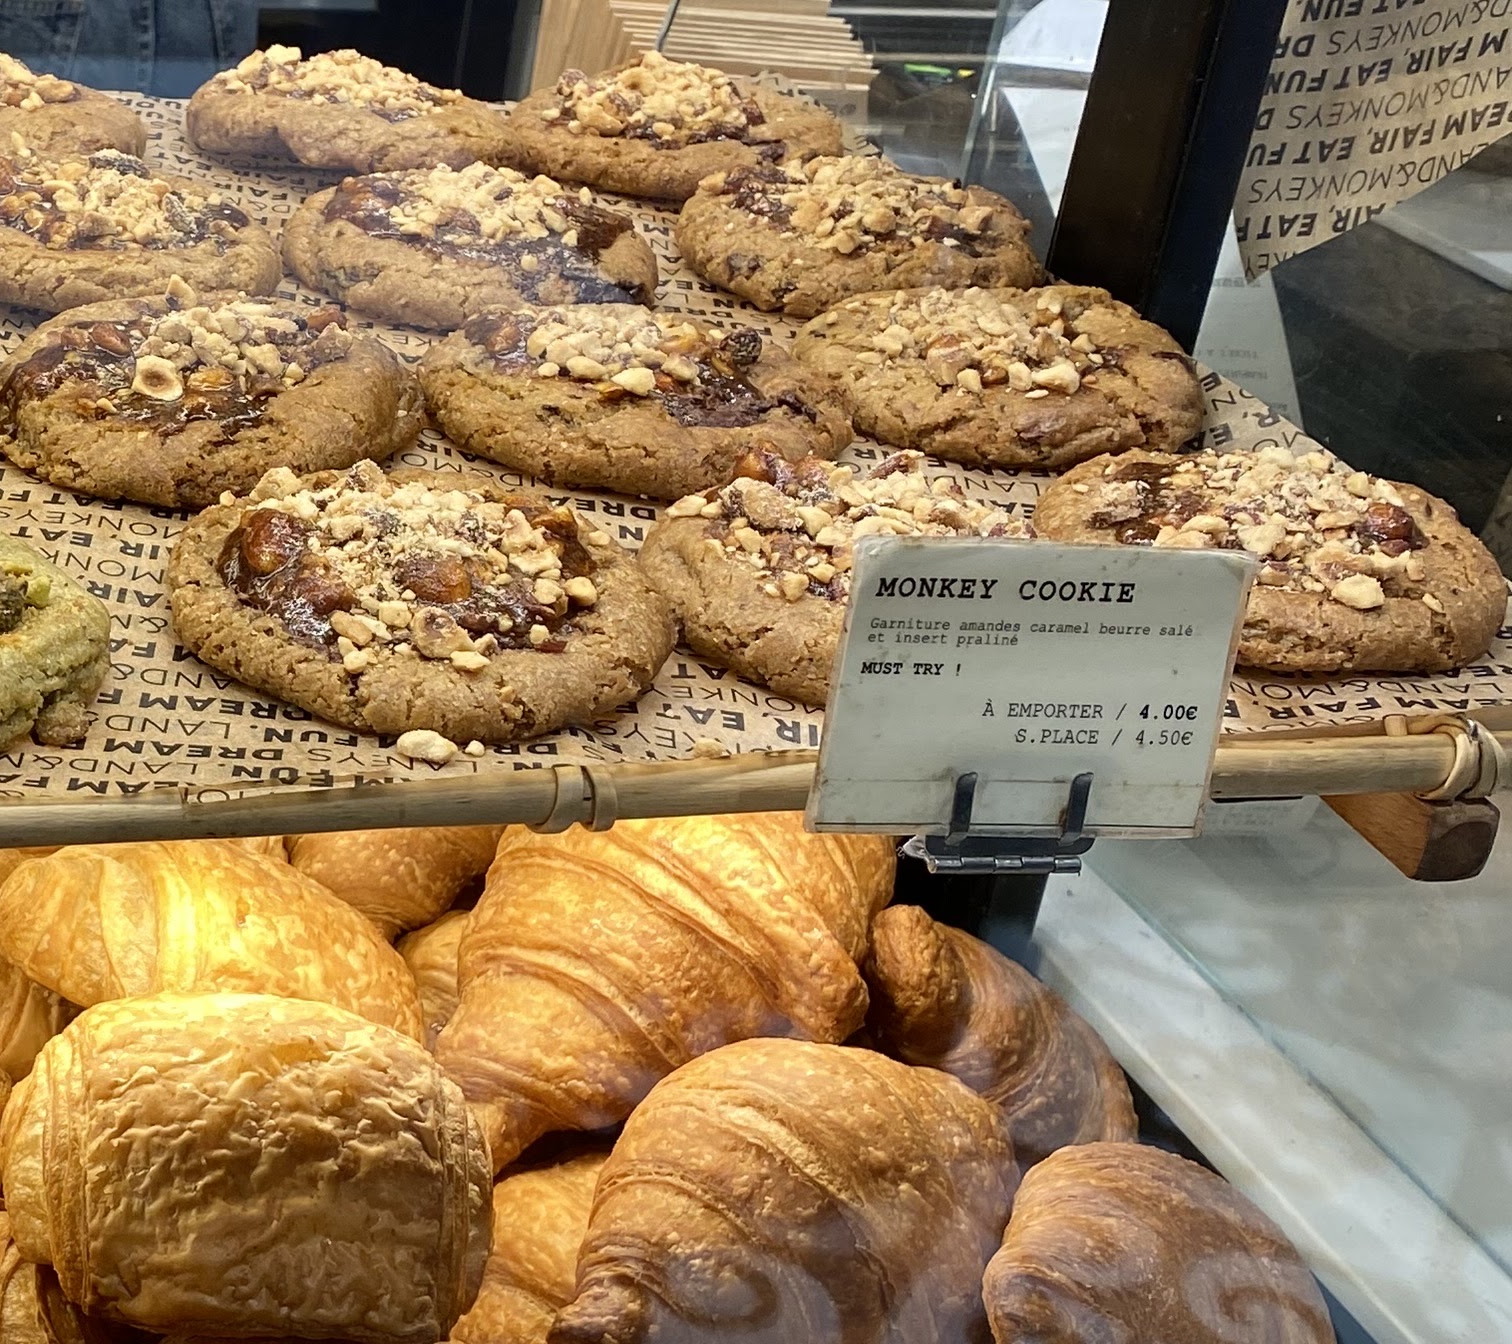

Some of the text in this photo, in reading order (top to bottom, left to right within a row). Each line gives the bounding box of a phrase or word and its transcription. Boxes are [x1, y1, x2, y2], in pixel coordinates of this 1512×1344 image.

[1403, 36, 1473, 75] FAIR,
[1333, 58, 1393, 90] EAT
[1285, 66, 1511, 130] AND&MONKEYS
[1366, 119, 1437, 154] FAIR,
[1292, 137, 1356, 164] EAT
[1256, 214, 1318, 242] EAT
[9, 526, 93, 548] EAT
[876, 577, 1137, 604] MONKEY COOKIE
[868, 632, 1019, 648] et insert praliné
[870, 617, 1193, 638] Garniture amandes caramel beurre salé
[860, 662, 962, 676] MUST TRY !
[982, 699, 1198, 721] À EMPORTER / 4.00€
[103, 738, 284, 761] DREAM
[1014, 729, 1193, 747] S.PLACE / 4.50€
